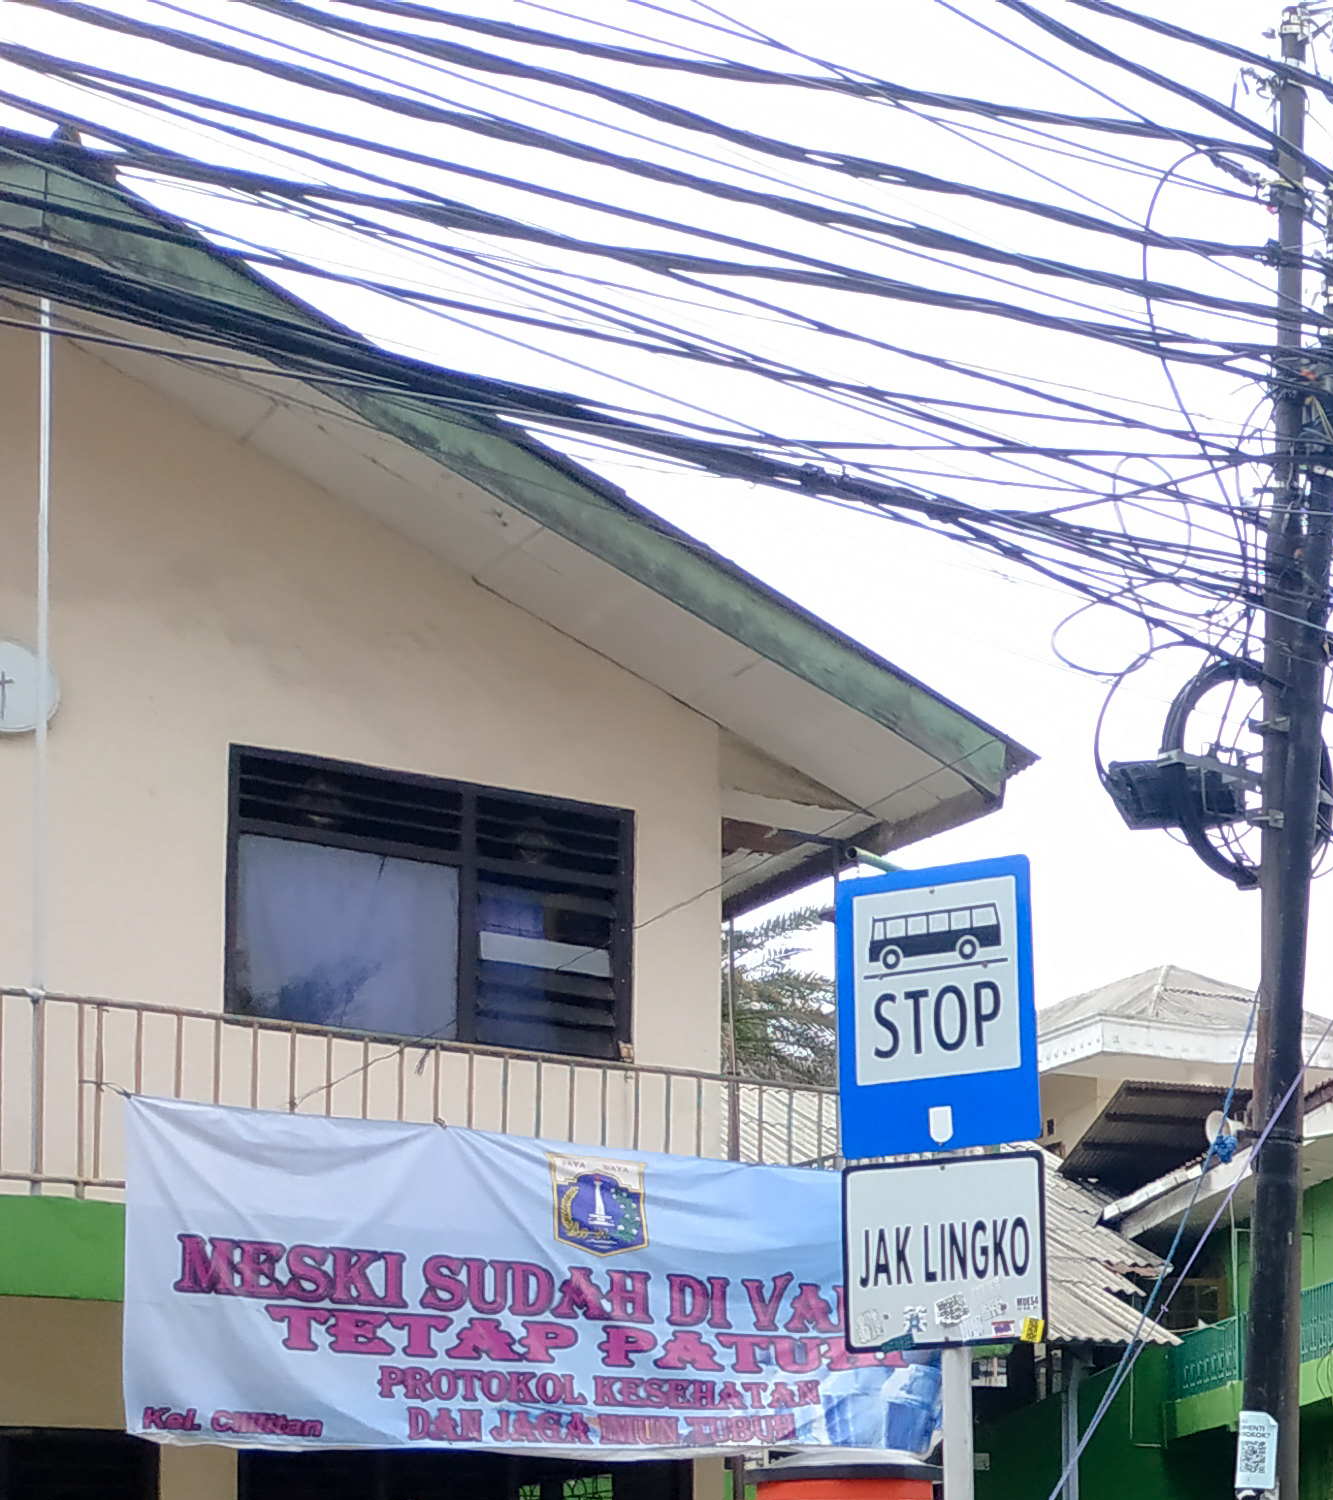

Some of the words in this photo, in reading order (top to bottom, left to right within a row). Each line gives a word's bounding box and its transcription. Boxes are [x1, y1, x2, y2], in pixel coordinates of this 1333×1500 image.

[872, 979, 1001, 1060] STOP
[859, 1223, 914, 1288] JAK
[923, 1216, 1031, 1283] LINGKO
[173, 1234, 408, 1308] MESKI
[419, 1254, 655, 1325] SUDAH
[666, 1273, 732, 1329] DI
[741, 1271, 845, 1333] VA
[265, 1304, 578, 1363] TETAP
[378, 1365, 588, 1405] PROTOKOL
[593, 1375, 821, 1410] KESEHATAN
[143, 1407, 201, 1431] Kel.
[408, 1407, 483, 1442] DAN
[489, 1409, 592, 1444] JAGA
